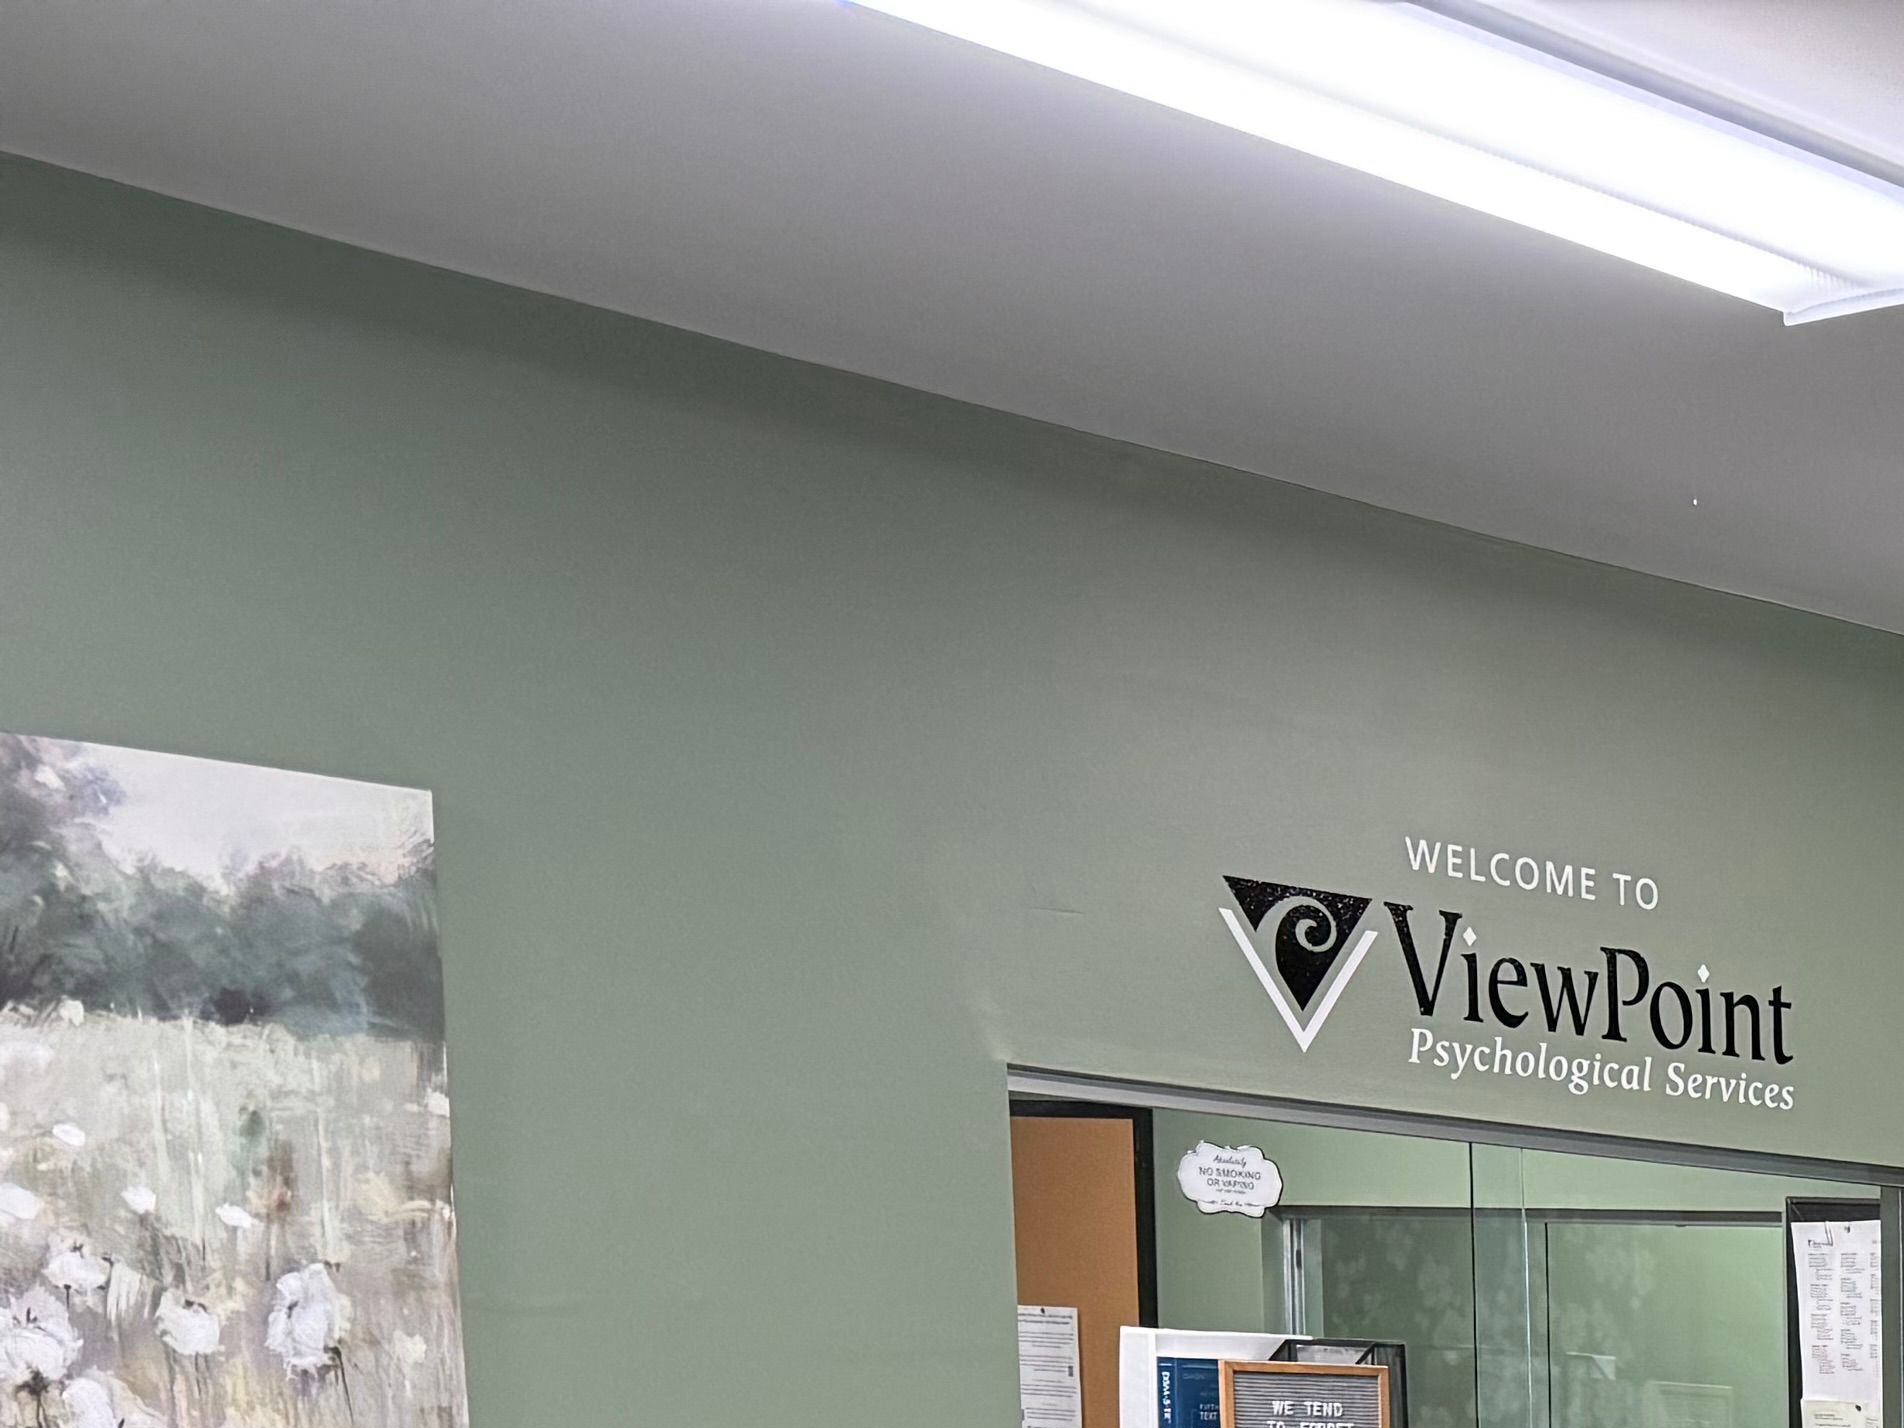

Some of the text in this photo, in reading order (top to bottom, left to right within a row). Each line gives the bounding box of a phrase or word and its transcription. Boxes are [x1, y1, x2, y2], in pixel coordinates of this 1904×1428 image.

[1404, 836, 1660, 910] WELCOME TO
[1383, 901, 1794, 1065] ViewPoint
[1408, 1028, 1795, 1111] Psychological Services
[1199, 1166, 1261, 1181] NO SMOKING
[1207, 1178, 1255, 1191] OR VAPING
[1271, 1400, 1344, 1417] WE TEND
